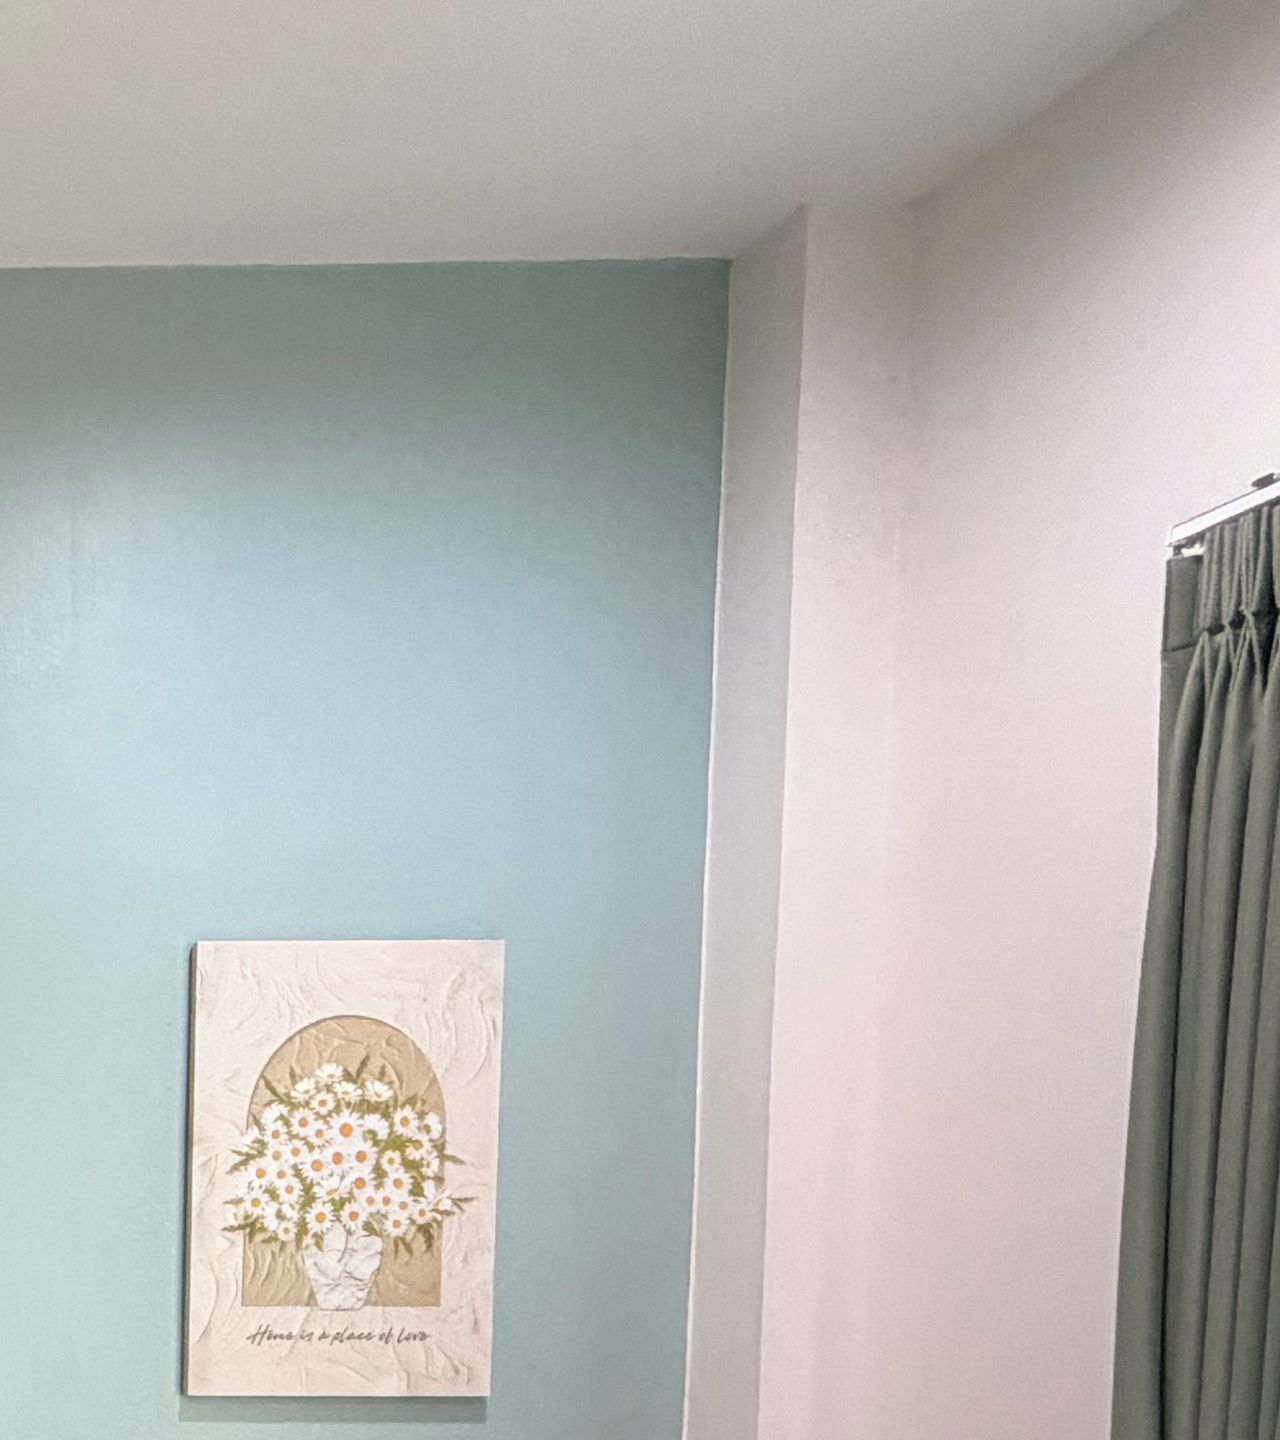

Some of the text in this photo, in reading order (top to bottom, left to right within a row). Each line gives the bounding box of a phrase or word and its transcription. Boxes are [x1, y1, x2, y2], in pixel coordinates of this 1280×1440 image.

[246, 1324, 295, 1346] Home
[299, 1330, 315, 1342] is
[329, 1326, 376, 1346] place
[378, 1327, 393, 1345] of
